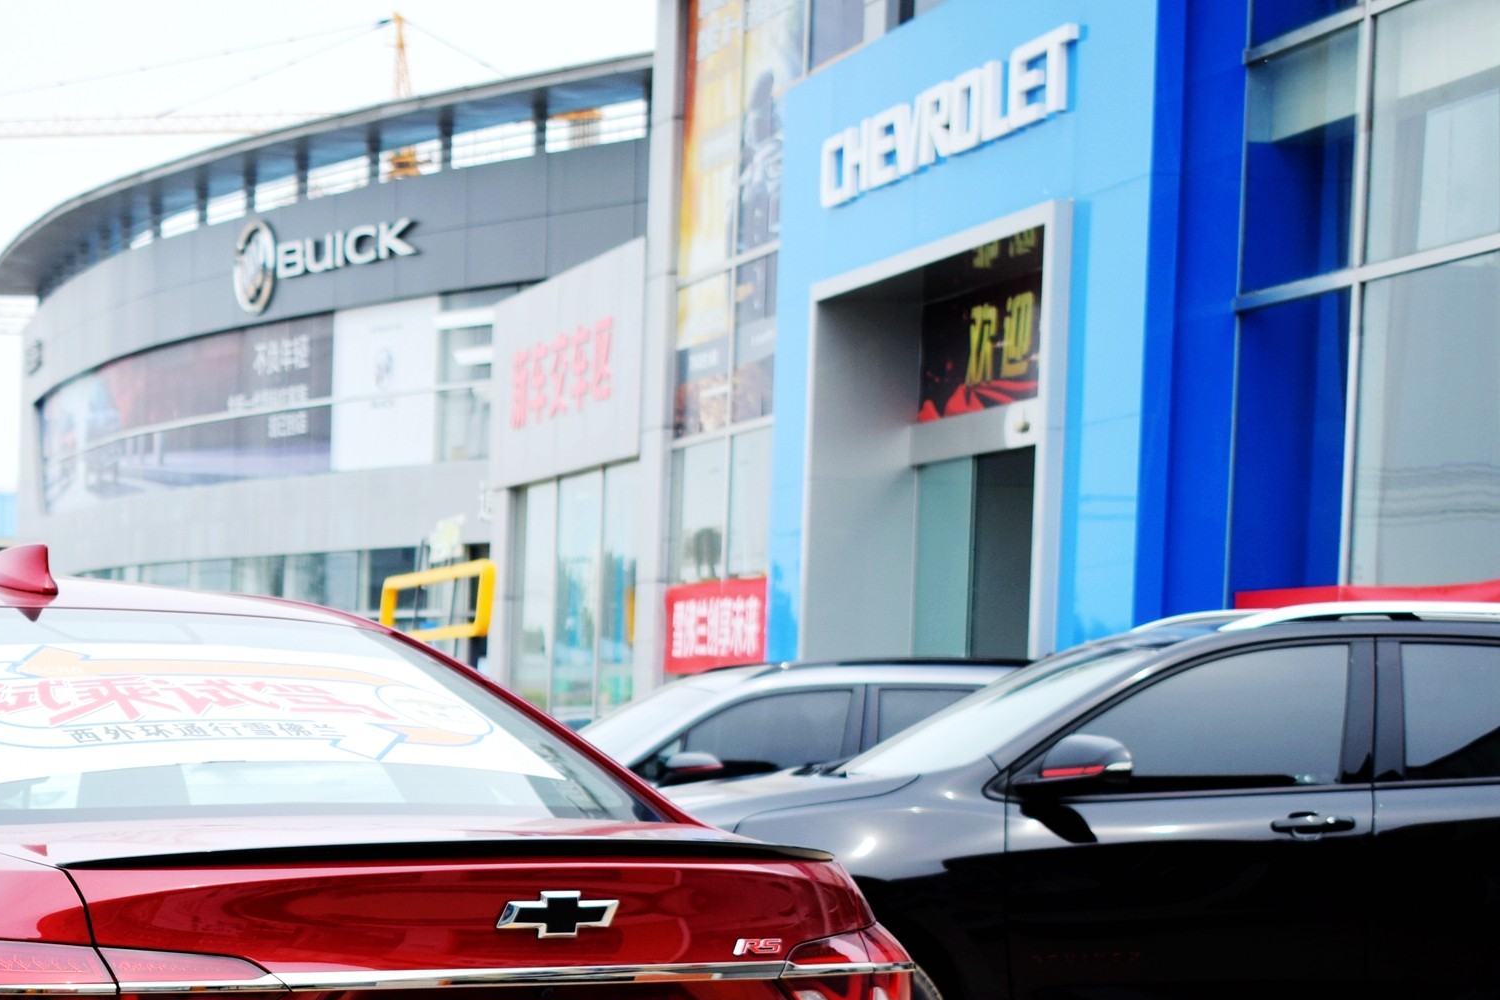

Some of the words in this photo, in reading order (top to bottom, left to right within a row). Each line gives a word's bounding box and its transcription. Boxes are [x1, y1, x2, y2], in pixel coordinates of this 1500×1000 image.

[820, 22, 1081, 209] CHEVROLET
[276, 217, 417, 279] BUICK
[509, 315, 614, 431] 新车交车区
[964, 290, 1036, 387] 欢迎
[62, 720, 348, 744] 西外环通行雪佛兰
[732, 937, 782, 957] RS
